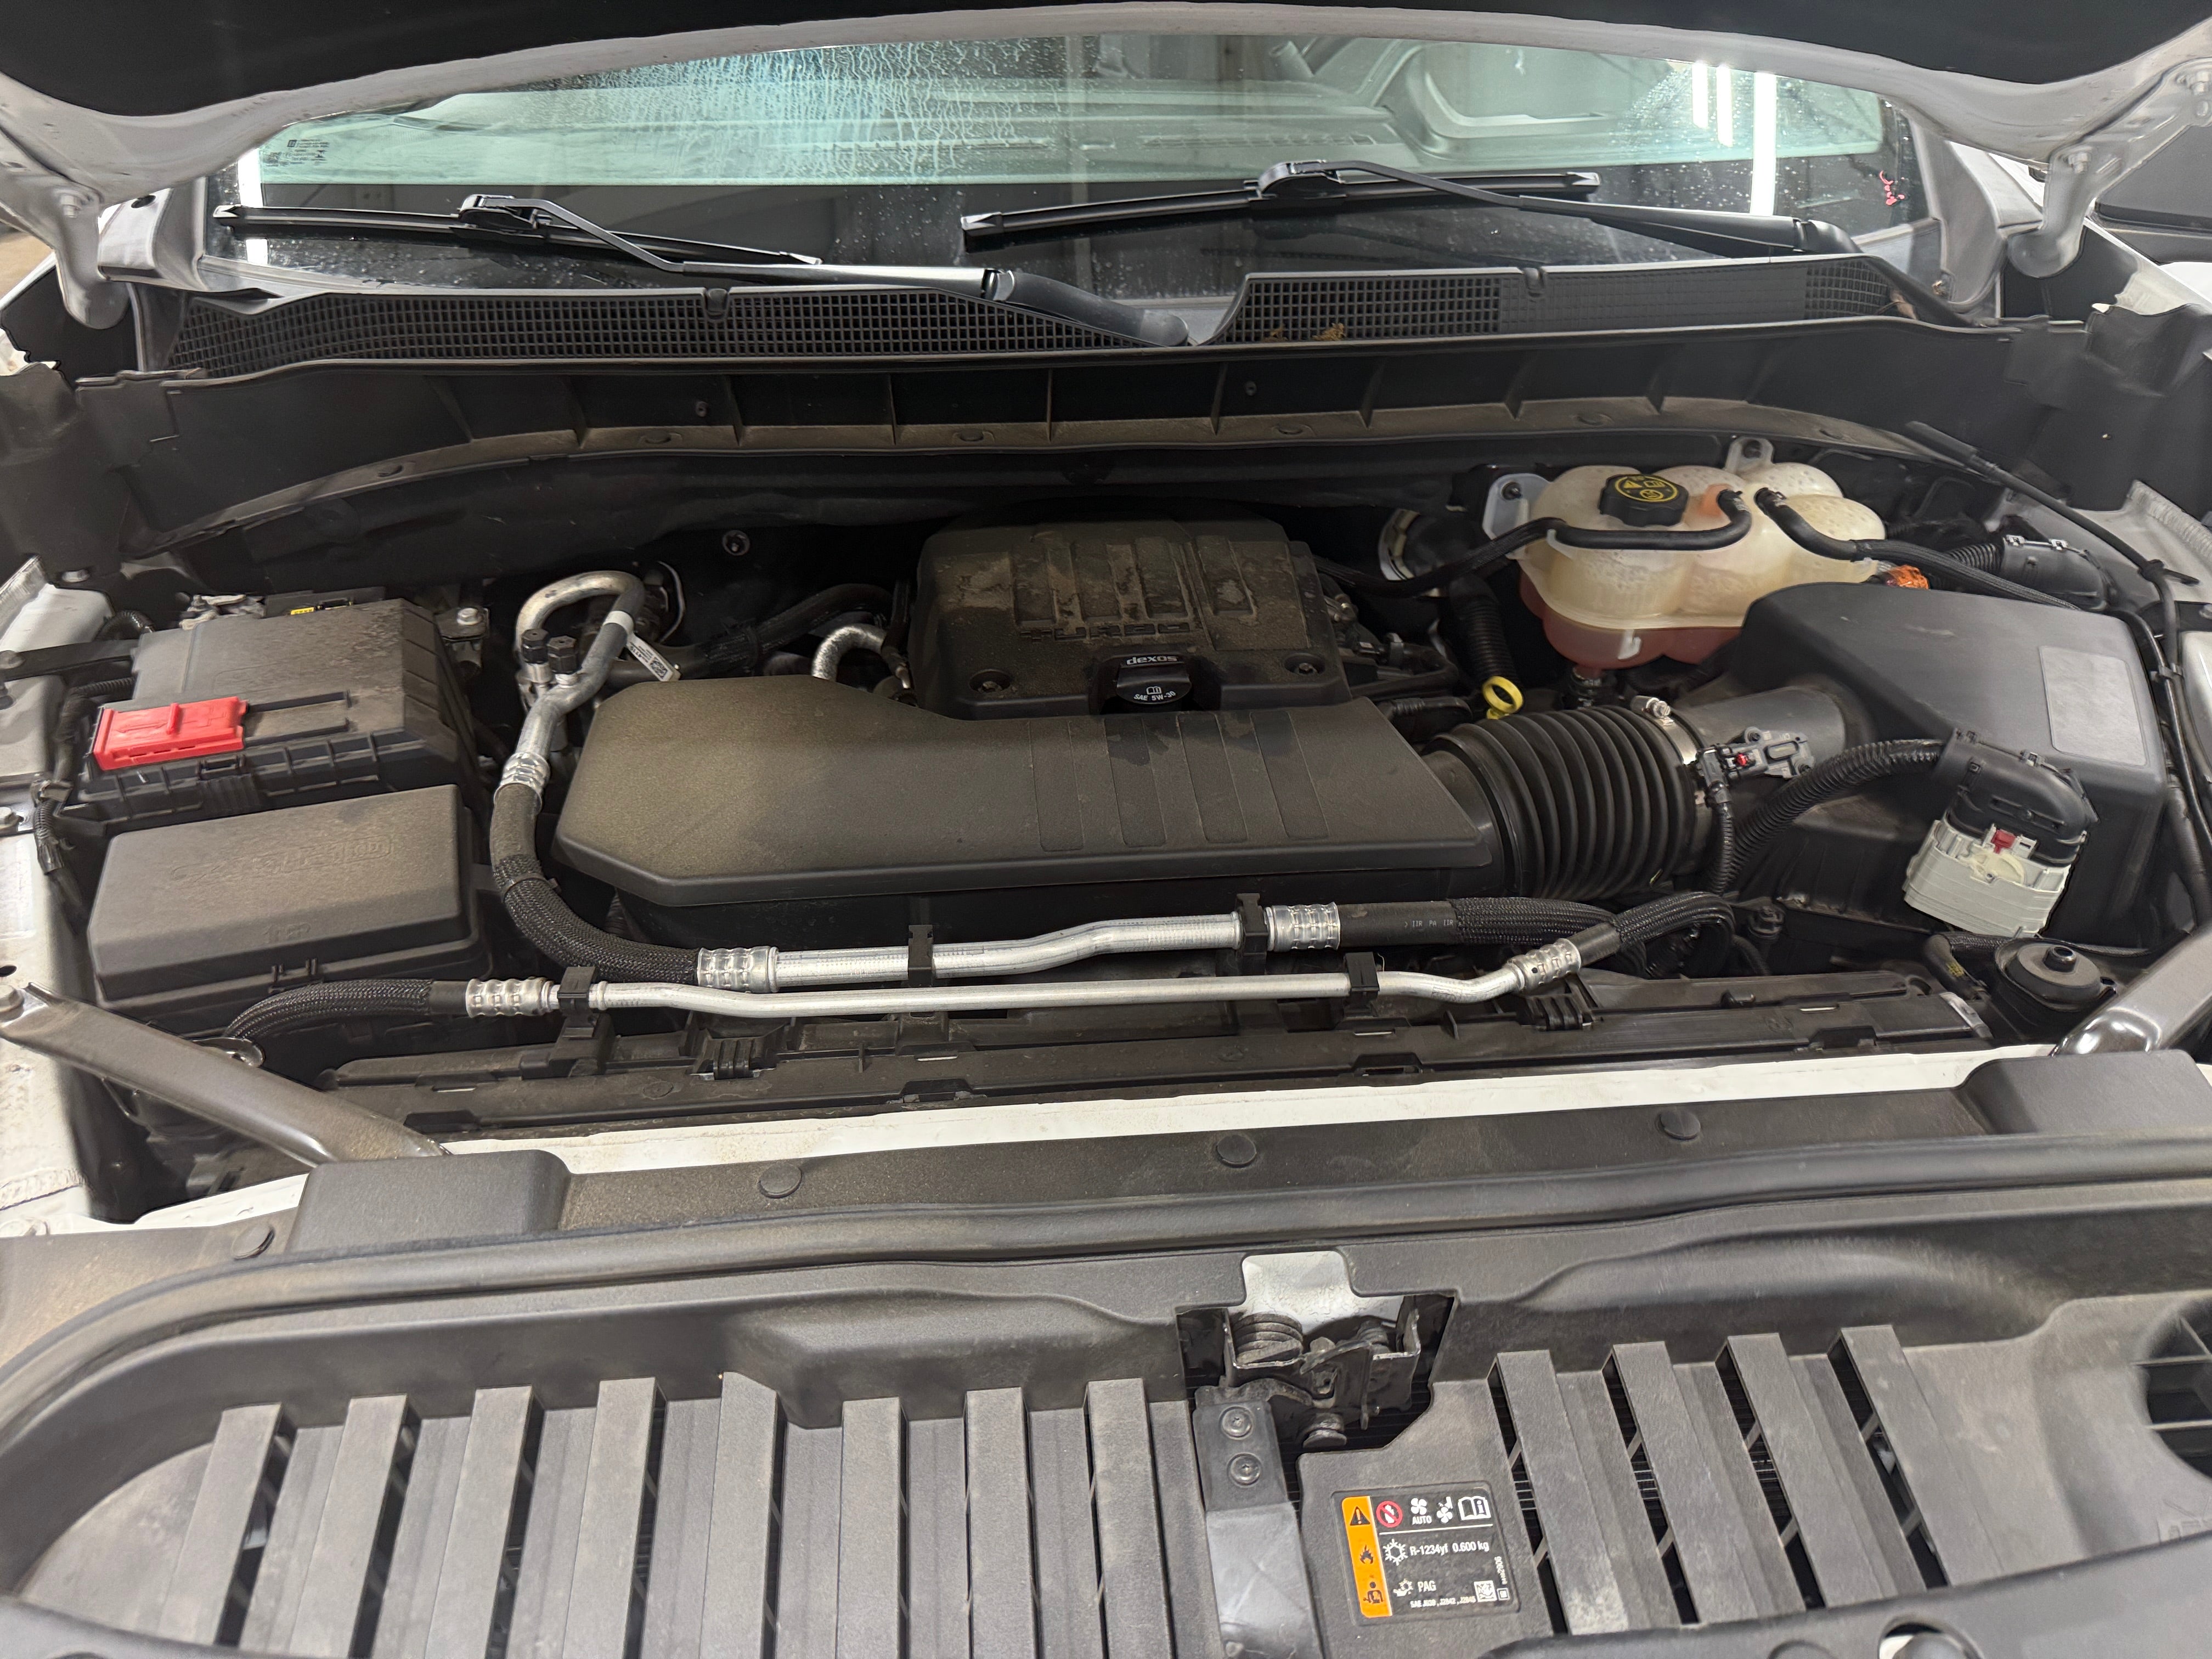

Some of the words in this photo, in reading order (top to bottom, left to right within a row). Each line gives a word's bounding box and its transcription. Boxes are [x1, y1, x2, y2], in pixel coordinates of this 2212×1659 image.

[1126, 656, 1177, 665] dexos
[1152, 691, 1176, 700] 5W-30
[1412, 1515, 1432, 1525] AUTO
[1409, 1543, 1448, 1556] R-1234yf
[1452, 1541, 1477, 1553] 0.600
[1477, 1541, 1489, 1553] kg
[1418, 1581, 1437, 1592] PAG
[1410, 1600, 1422, 1608] SAE
